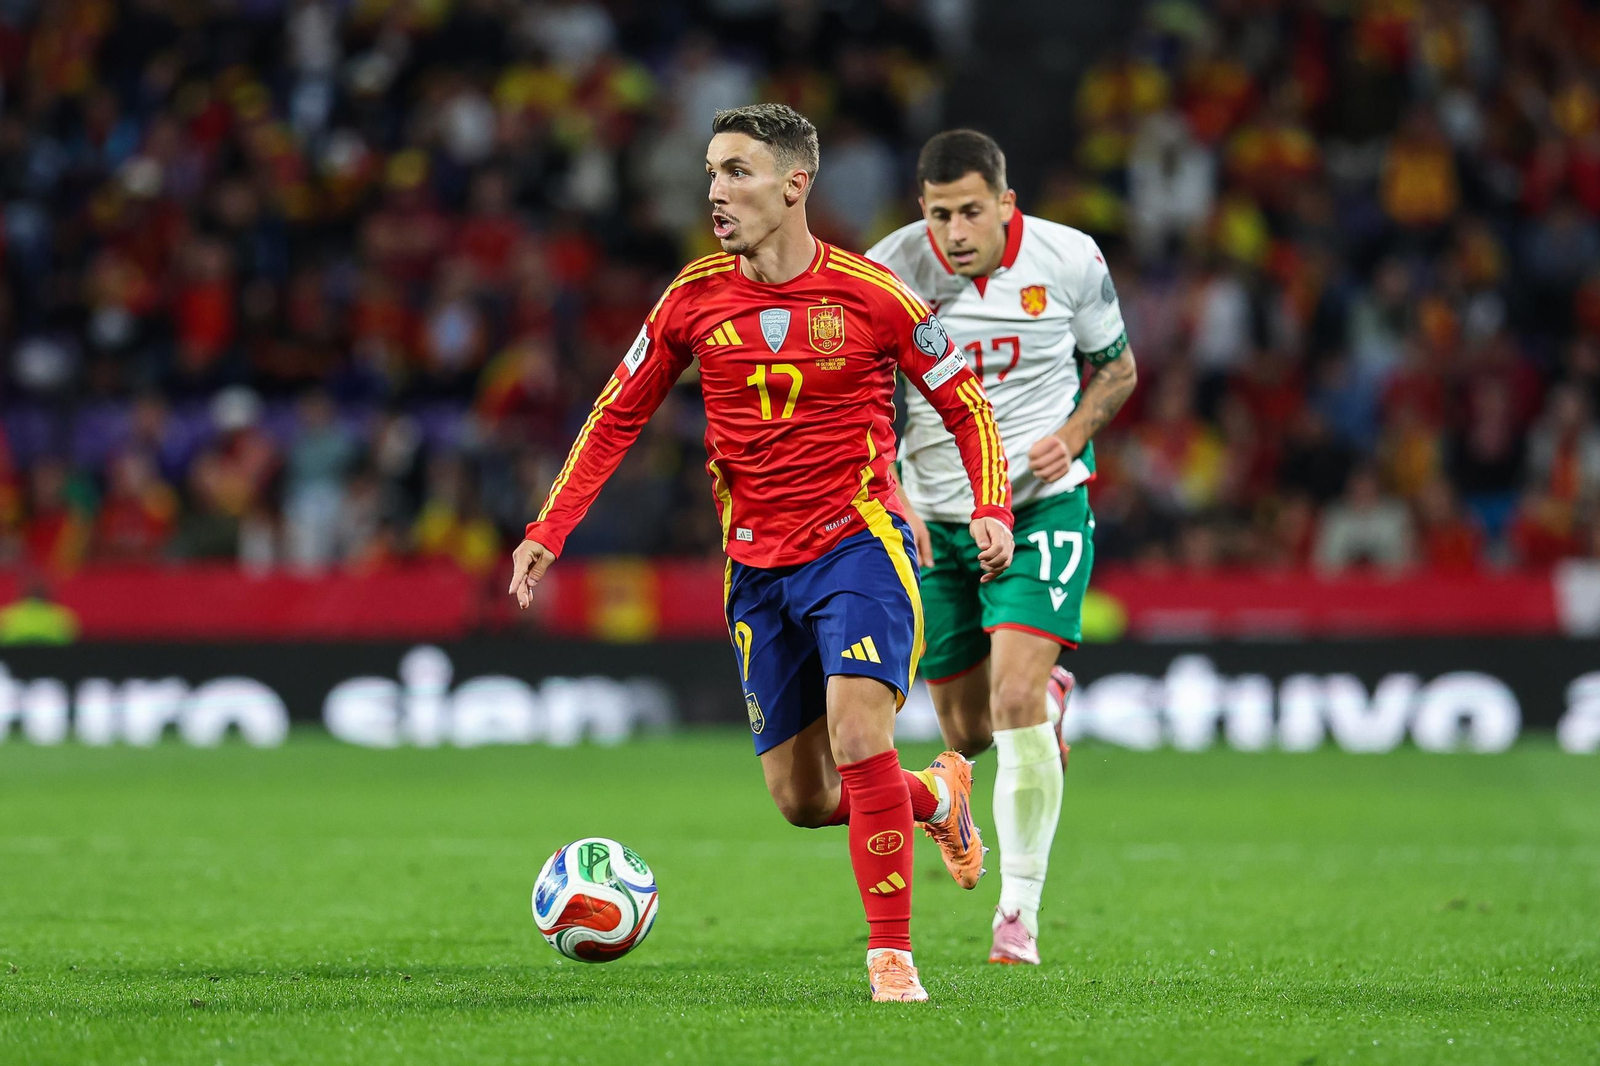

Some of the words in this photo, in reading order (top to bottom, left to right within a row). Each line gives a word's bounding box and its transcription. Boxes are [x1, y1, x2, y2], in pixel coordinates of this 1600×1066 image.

[964, 336, 1020, 383] 17
[746, 363, 804, 421] 17
[1027, 530, 1083, 585] 17
